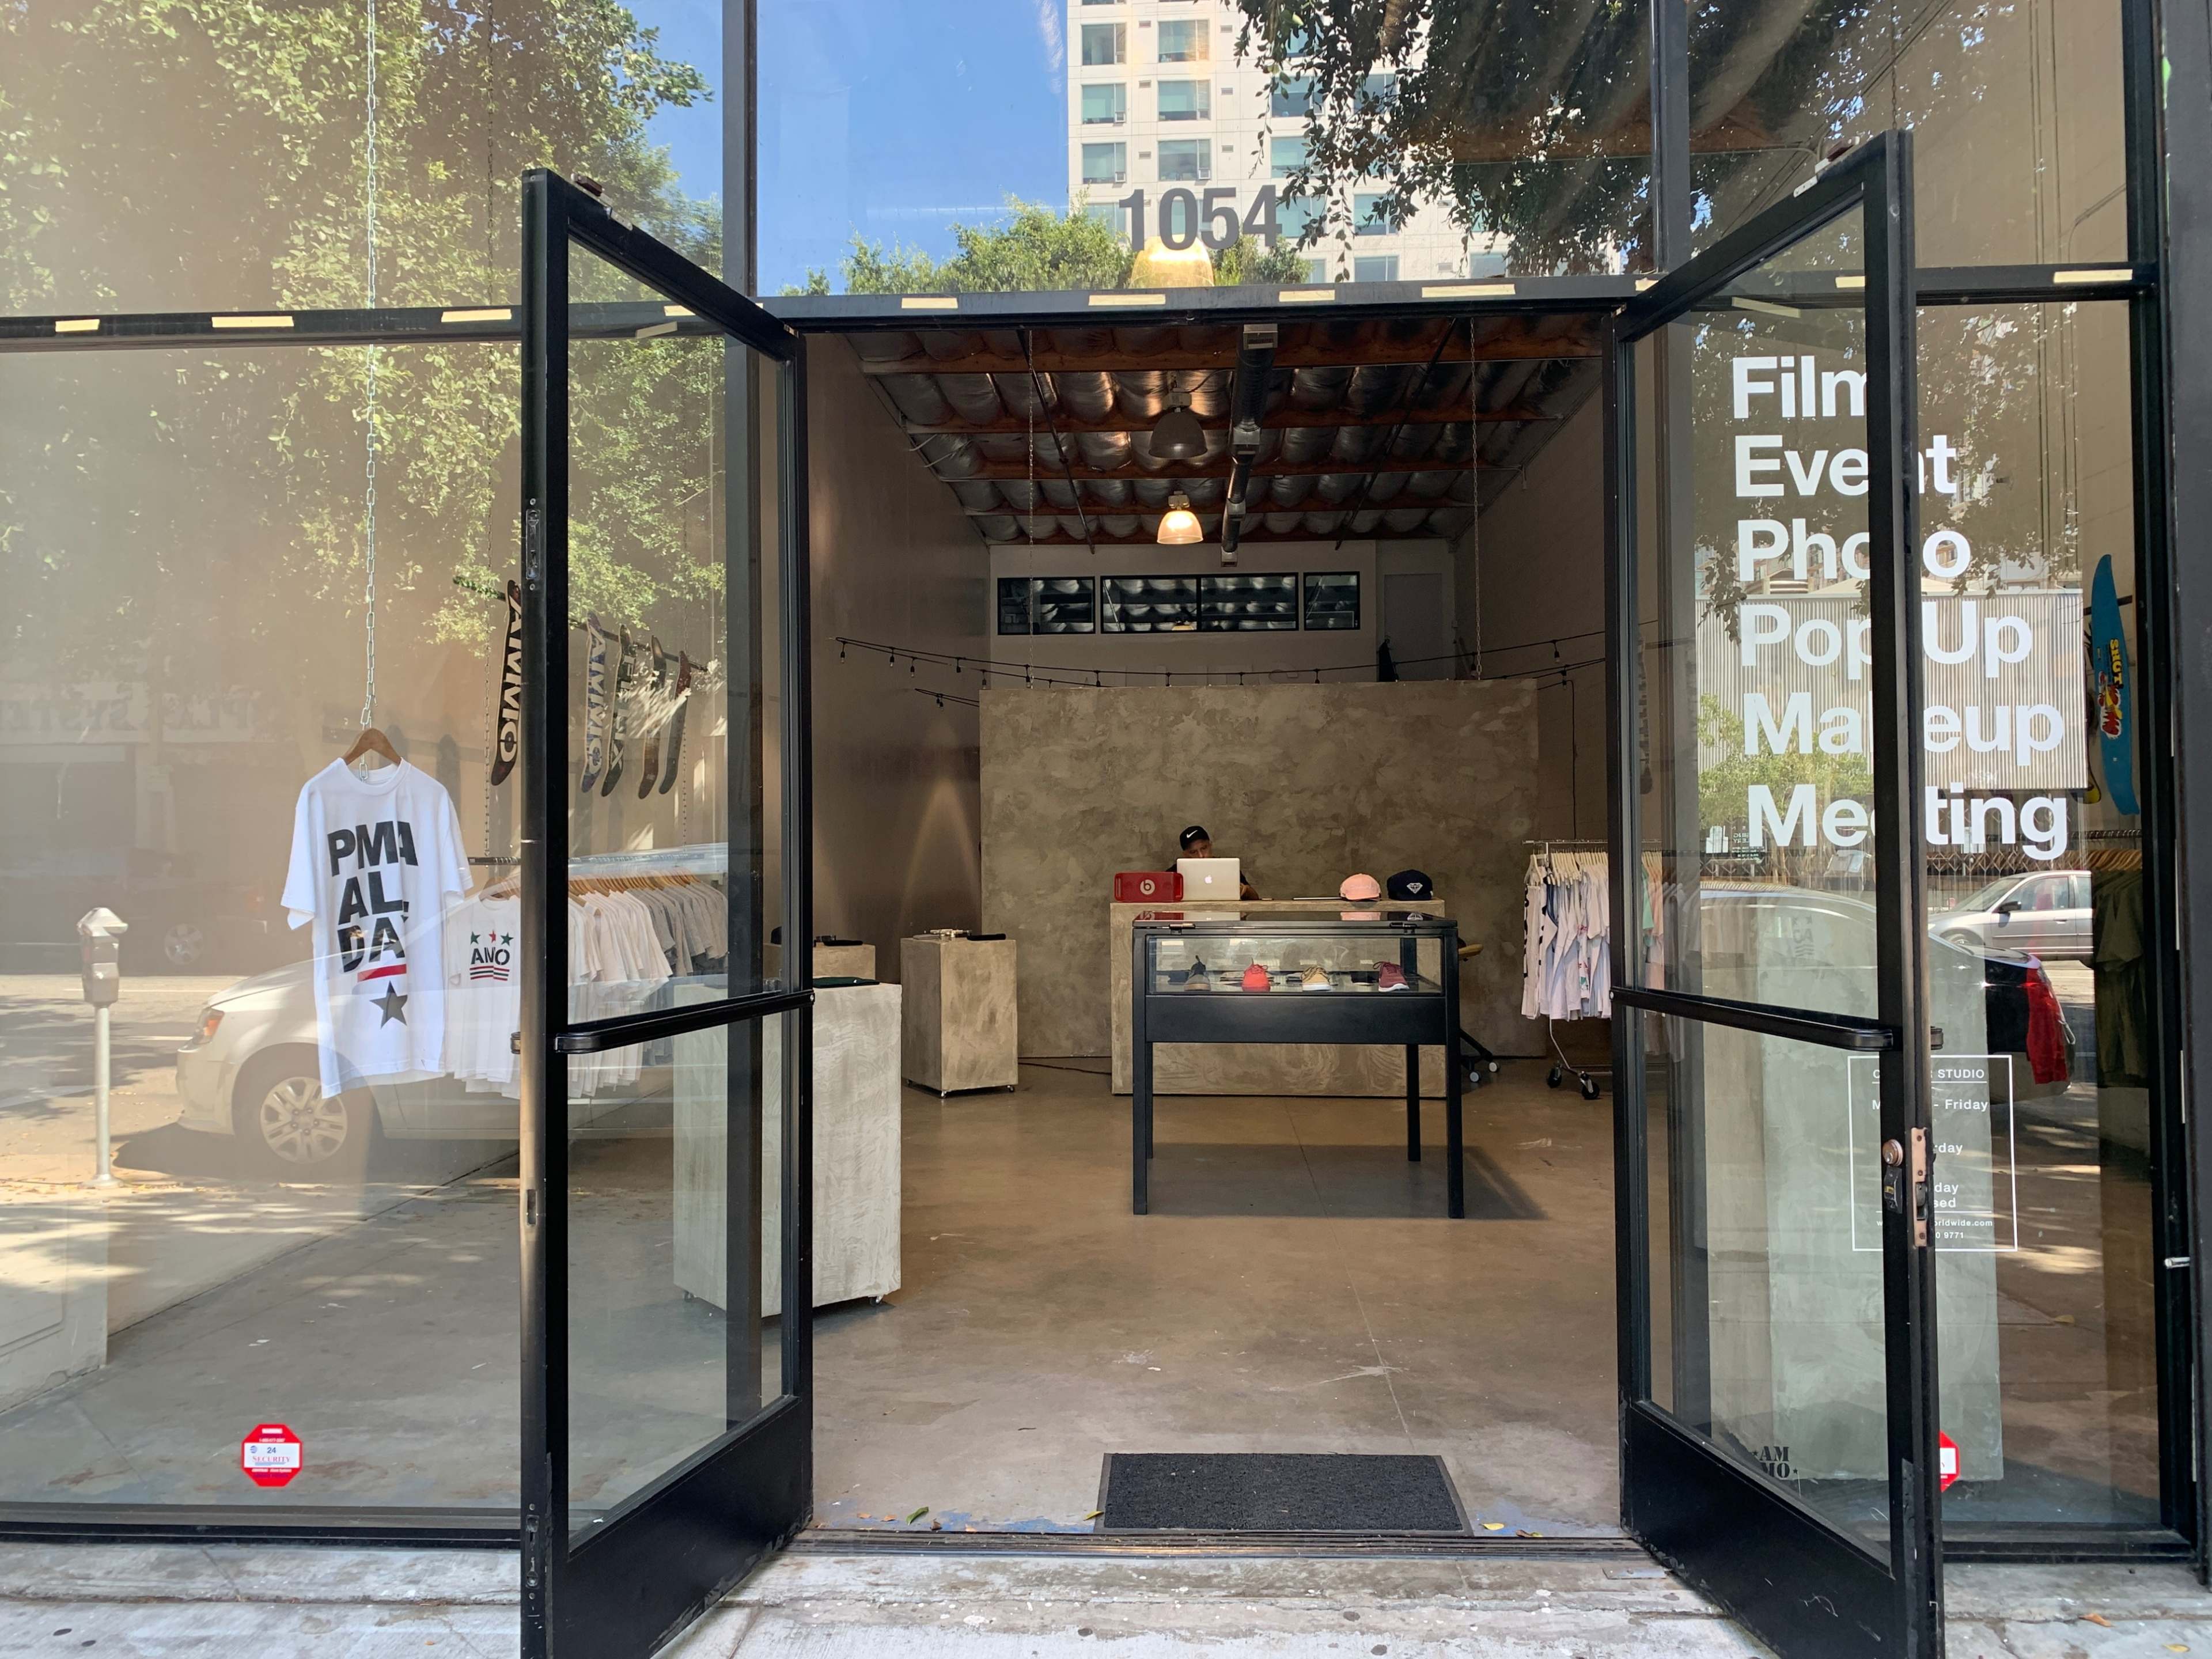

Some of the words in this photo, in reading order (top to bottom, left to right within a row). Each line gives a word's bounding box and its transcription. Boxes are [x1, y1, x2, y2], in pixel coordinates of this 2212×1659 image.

[1119, 184, 1282, 251] 1054
[1735, 434, 1957, 497] Evet
[1737, 518, 1971, 581] Phoo
[1922, 600, 2033, 678] Up
[2109, 638, 2123, 686] SHUT
[1743, 691, 2063, 766] Maeup
[327, 821, 419, 877] PMA
[1748, 782, 2067, 861] Meting
[1938, 1069, 1985, 1079] STUDIO
[1945, 1099, 1988, 1112] Friday
[1759, 1446, 1789, 1461] AM
